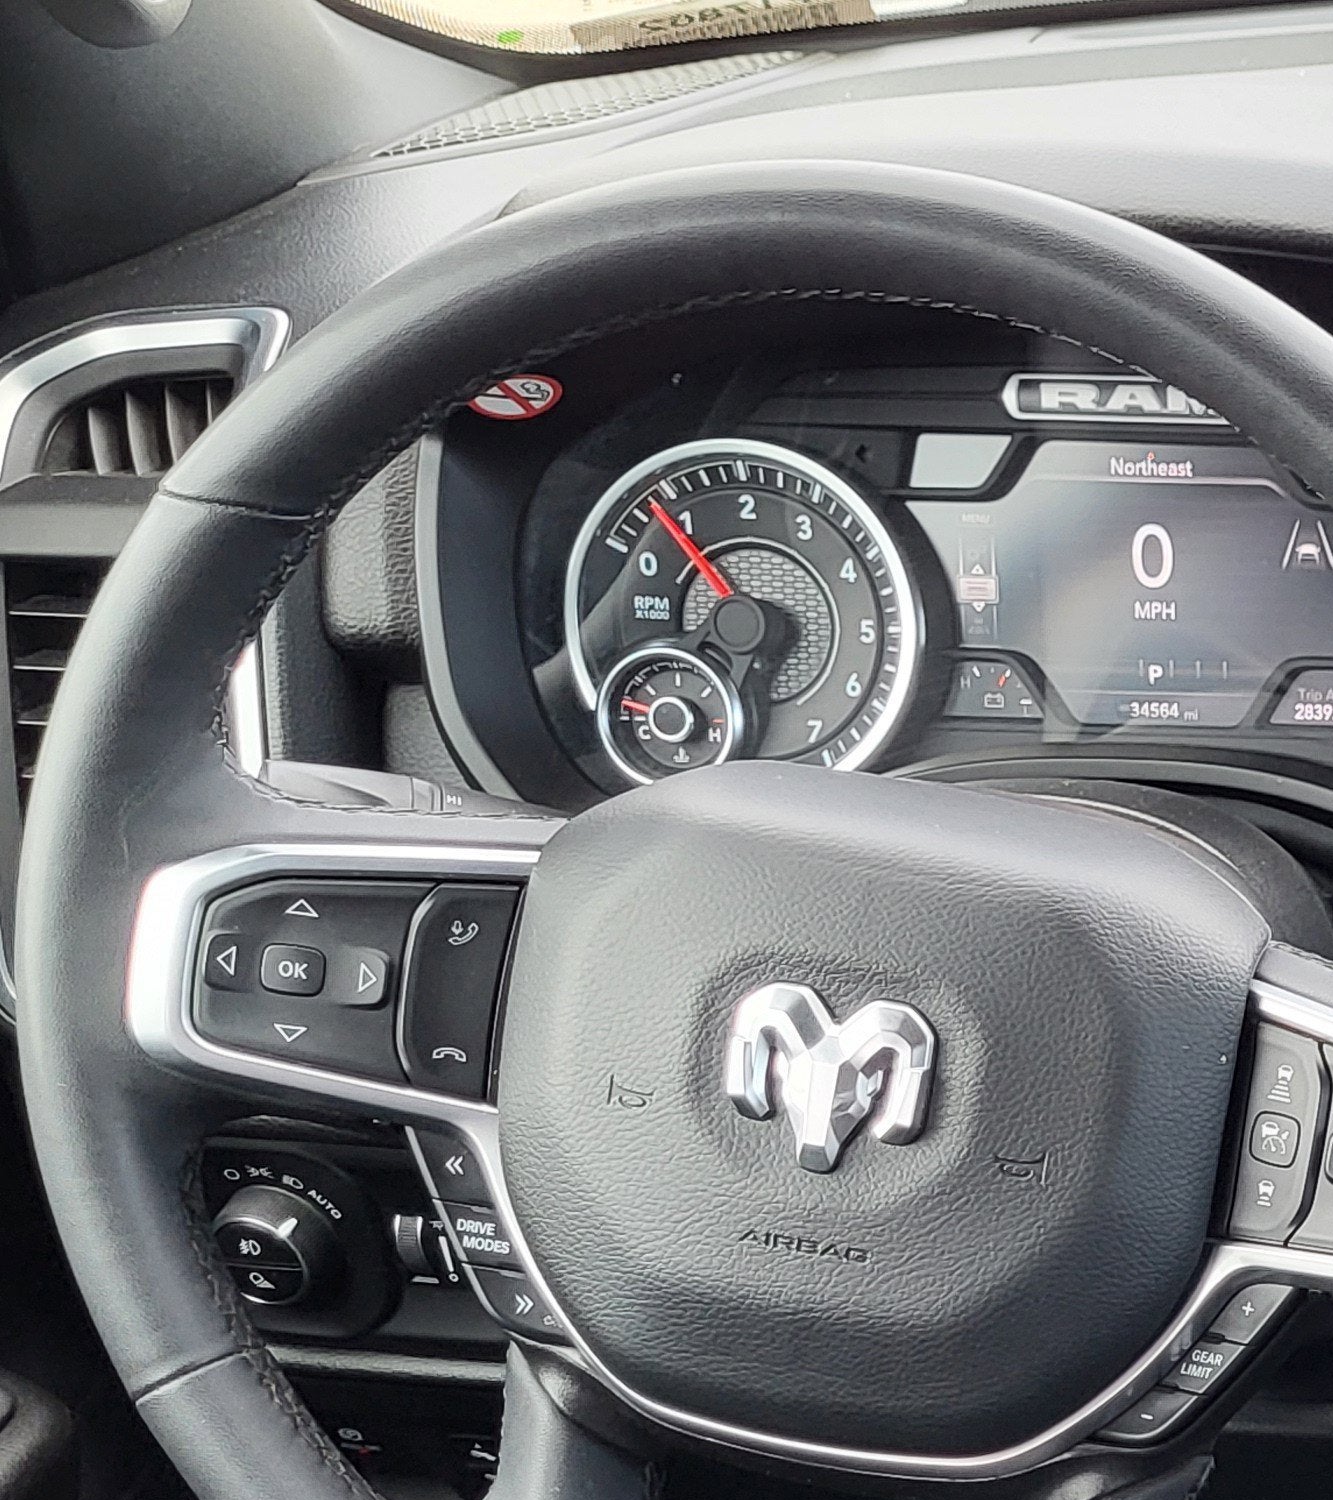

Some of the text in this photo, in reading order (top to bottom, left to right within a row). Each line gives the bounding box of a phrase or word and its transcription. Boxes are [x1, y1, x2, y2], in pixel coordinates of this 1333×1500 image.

[1110, 456, 1194, 478] Northeast
[739, 496, 757, 520] 2
[680, 512, 694, 534] 1
[796, 515, 813, 541] 3
[639, 551, 658, 577] 0
[1131, 524, 1175, 588] 0
[840, 559, 857, 583] 4
[634, 596, 669, 611] RPM
[1134, 601, 1176, 621] MPH
[860, 619, 875, 643] 5
[846, 673, 862, 698] 6
[1148, 664, 1164, 685] P
[1298, 688, 1325, 702] Trip
[1129, 702, 1180, 719] 34564
[638, 725, 652, 740] C
[708, 727, 721, 742] H
[807, 719, 824, 744] 7
[278, 959, 308, 981] OK
[306, 1186, 343, 1221] AUTO
[456, 1218, 496, 1237] DRIVE
[462, 1235, 511, 1255] MODES
[738, 1229, 870, 1264] AIRBAG
[1191, 1347, 1224, 1367] GEAR
[1180, 1362, 1214, 1380] LIMIT
